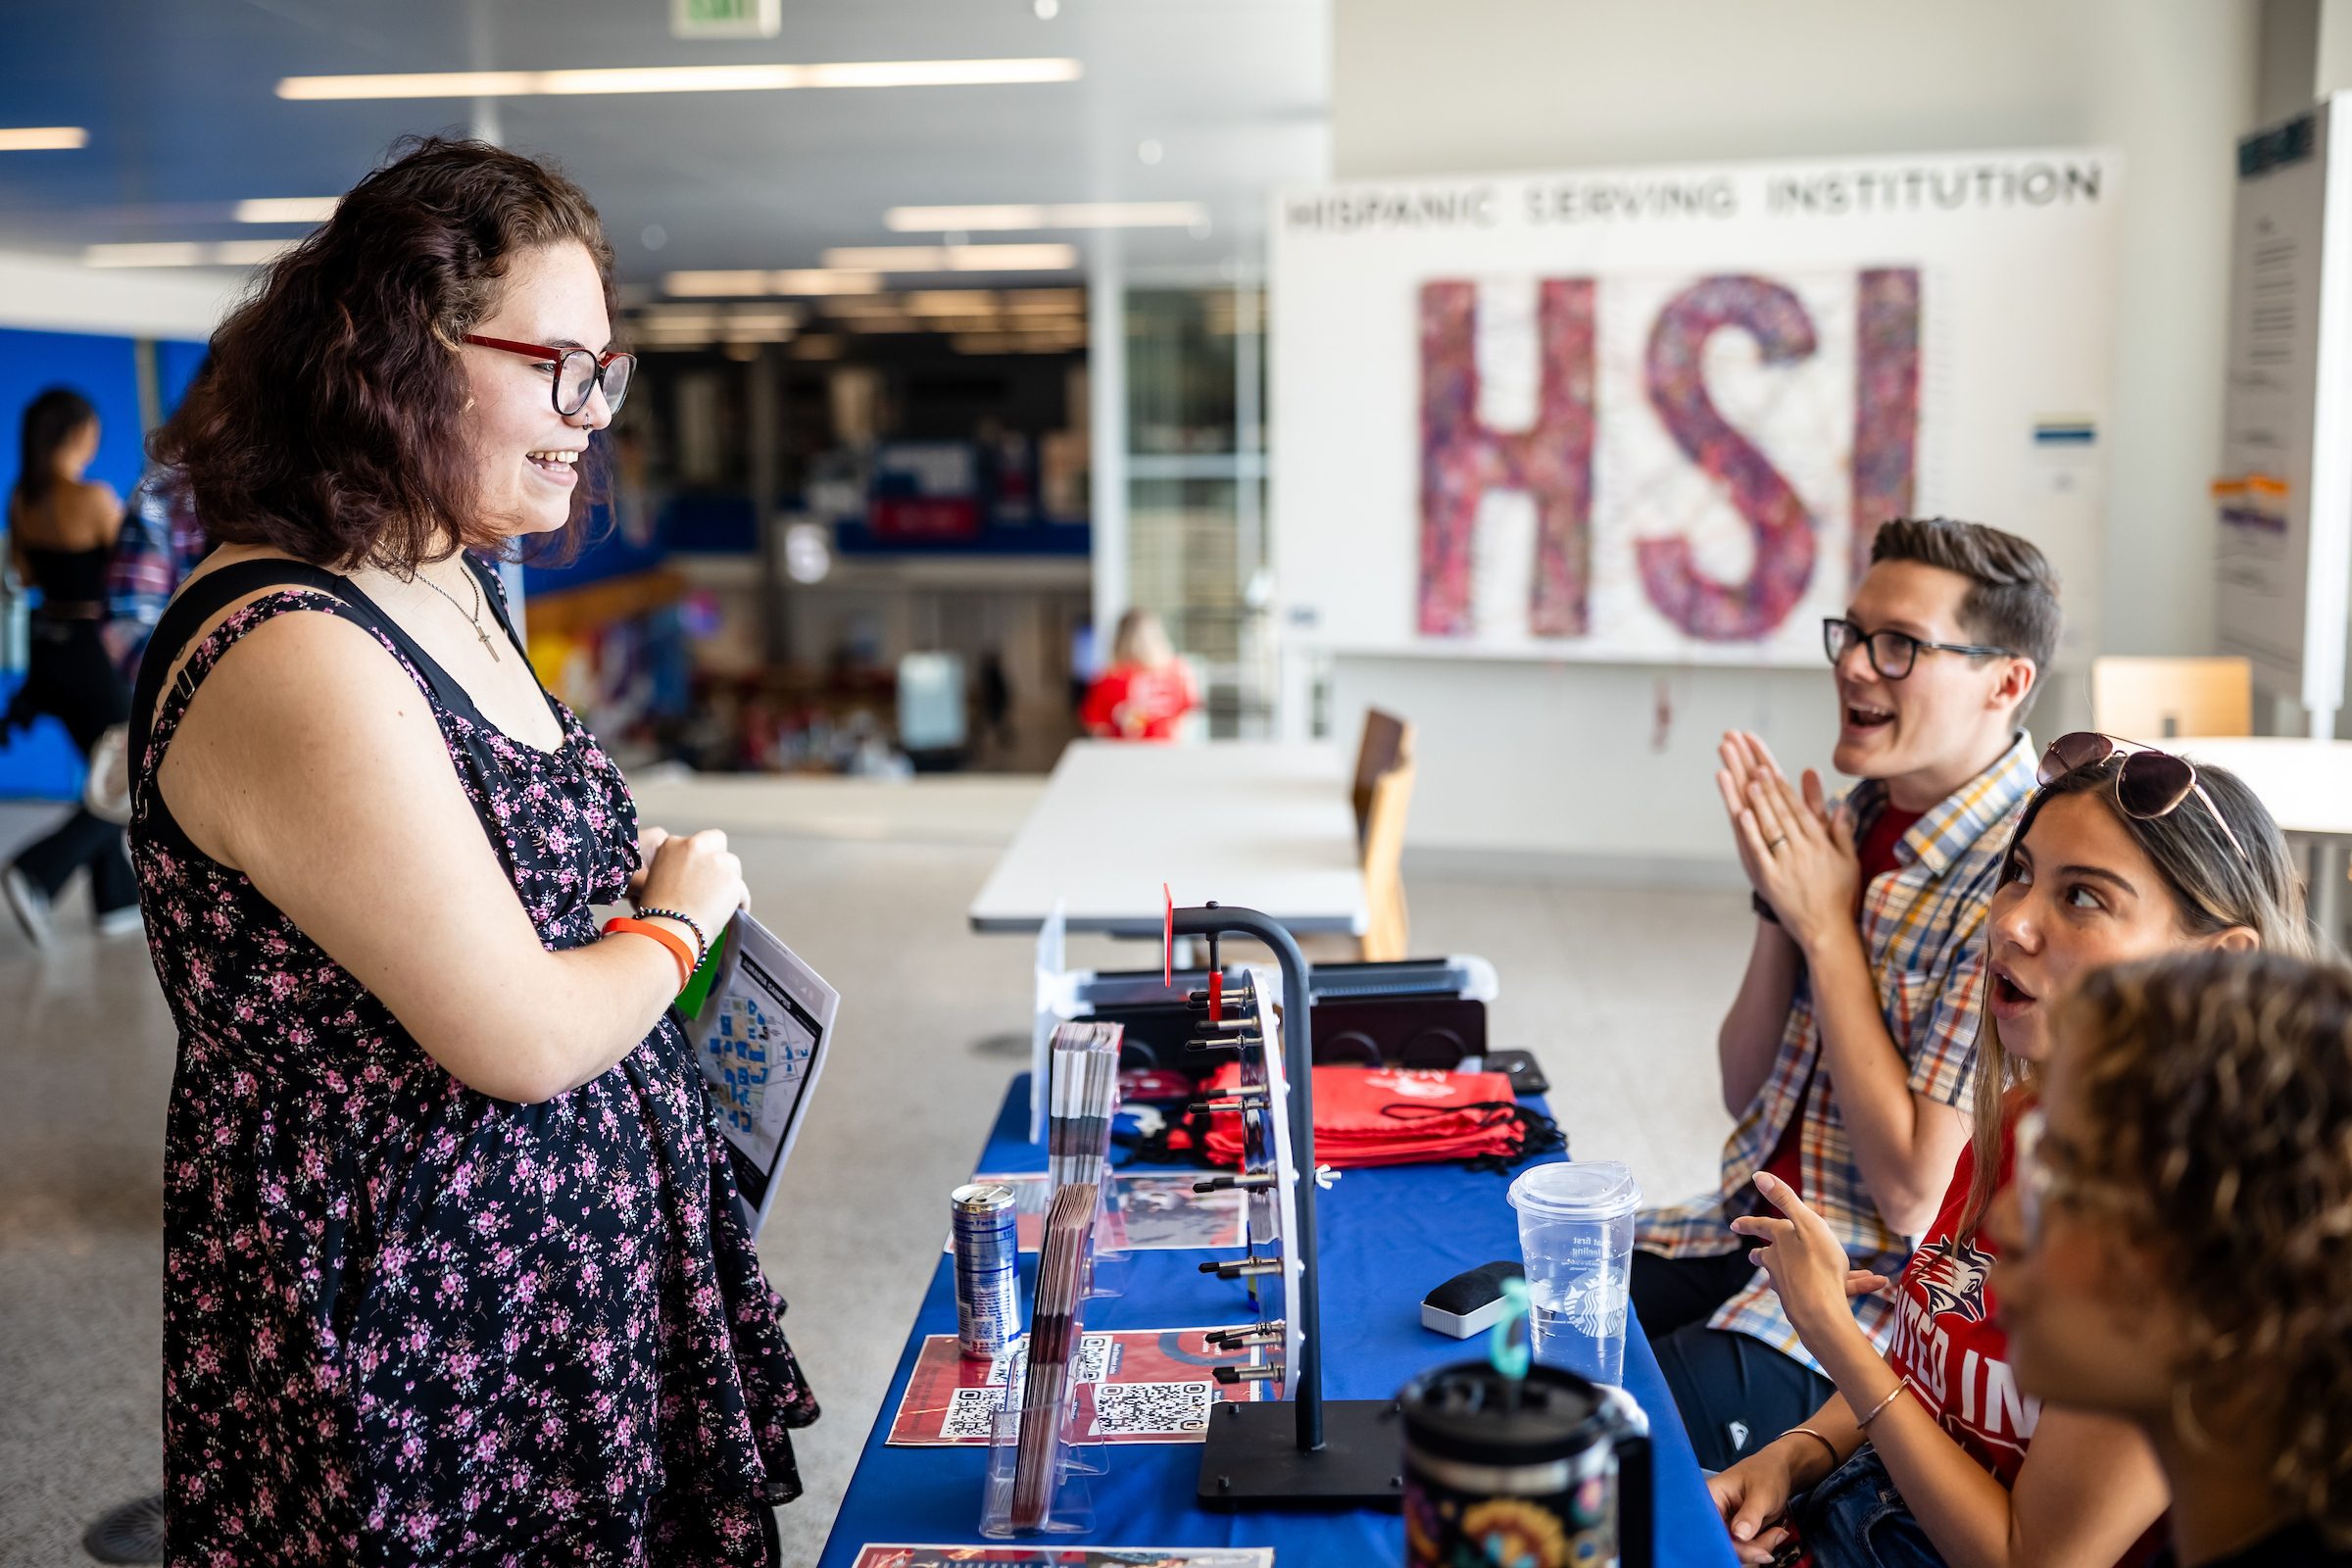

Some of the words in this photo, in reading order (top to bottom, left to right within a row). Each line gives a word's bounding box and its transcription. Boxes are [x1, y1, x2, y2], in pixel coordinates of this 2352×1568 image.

[1285, 187, 1500, 231] HISPANIC
[1524, 175, 1739, 225] SERVING
[1767, 161, 2103, 218] INSTITUTION
[1417, 266, 1920, 642] HSI
[1962, 1348, 2043, 1440] IN
